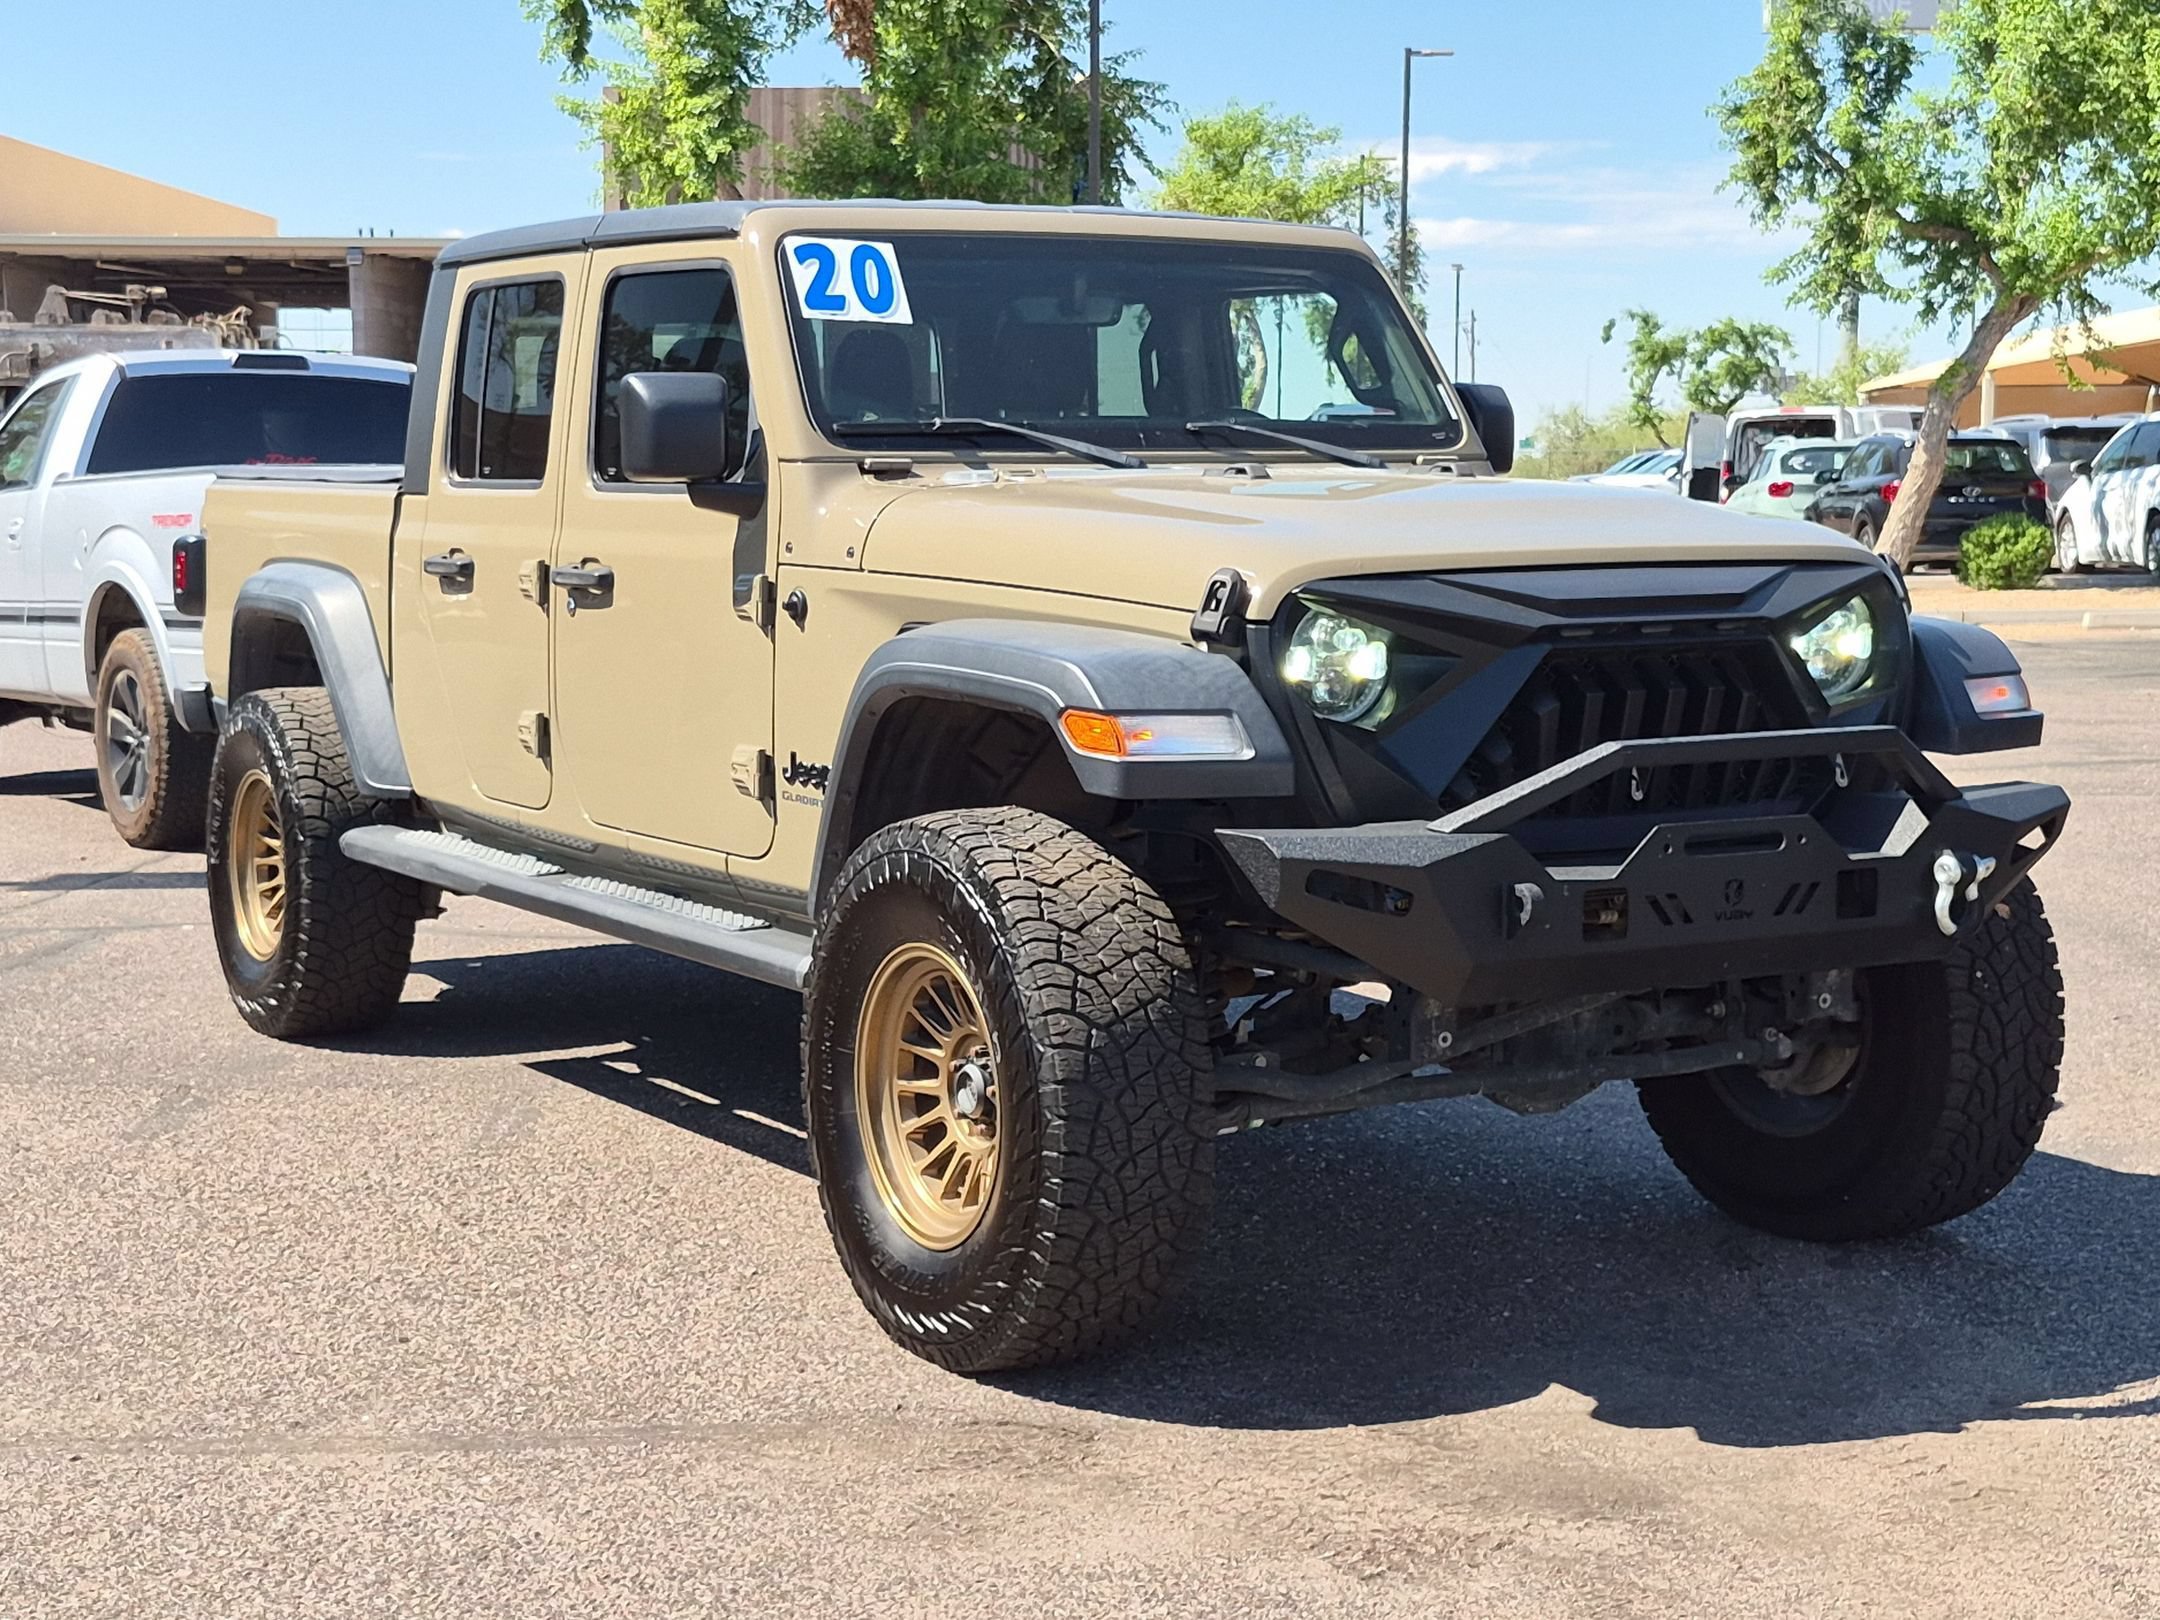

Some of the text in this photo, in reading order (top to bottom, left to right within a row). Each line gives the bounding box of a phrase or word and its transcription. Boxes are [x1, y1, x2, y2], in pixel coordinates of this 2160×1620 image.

[793, 242, 895, 314] 20
[782, 751, 831, 795] Jeep
[781, 790, 821, 808] GLADIA
